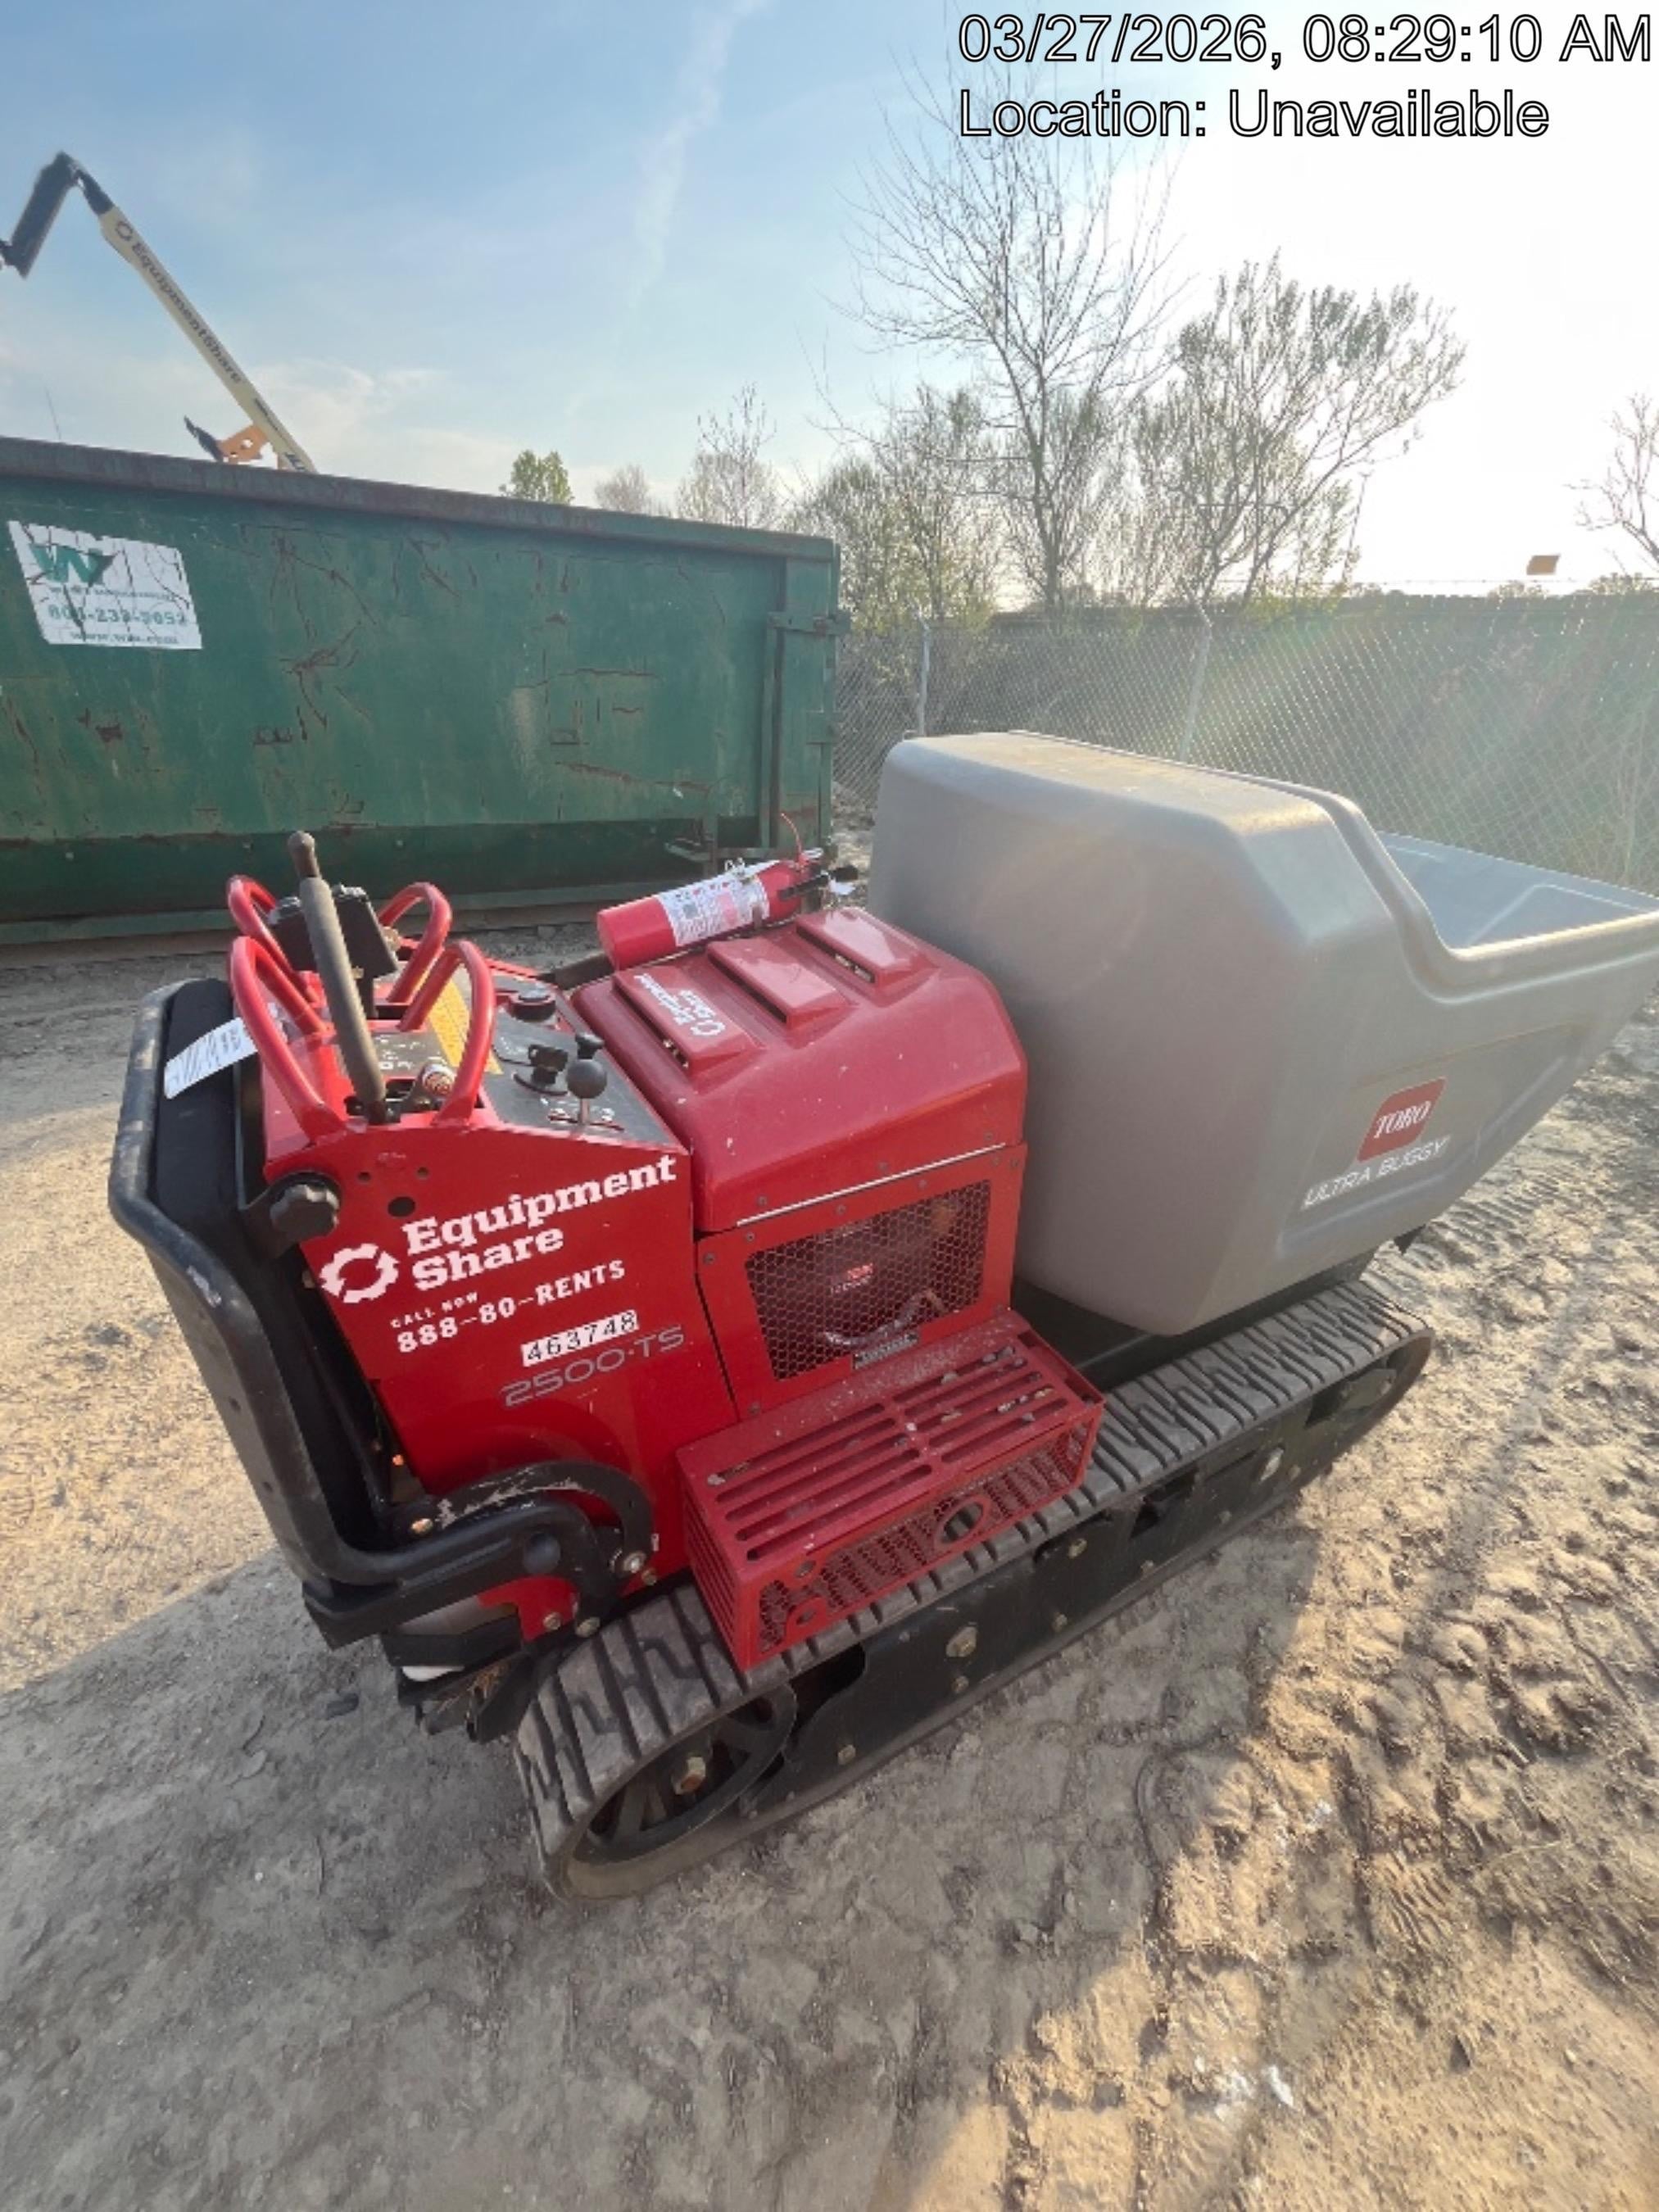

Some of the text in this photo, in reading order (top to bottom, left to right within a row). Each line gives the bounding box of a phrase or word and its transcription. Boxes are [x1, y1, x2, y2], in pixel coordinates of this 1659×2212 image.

[1373, 1100, 1432, 1139] TORO
[1301, 1135, 1451, 1207] ULTRA BUGGY
[401, 1154, 678, 1255] Equipment
[410, 1228, 564, 1291] Share
[390, 1291, 479, 1328] CALL NOW
[397, 1259, 626, 1353] 888-80-RENTS
[527, 1311, 637, 1363] 463748
